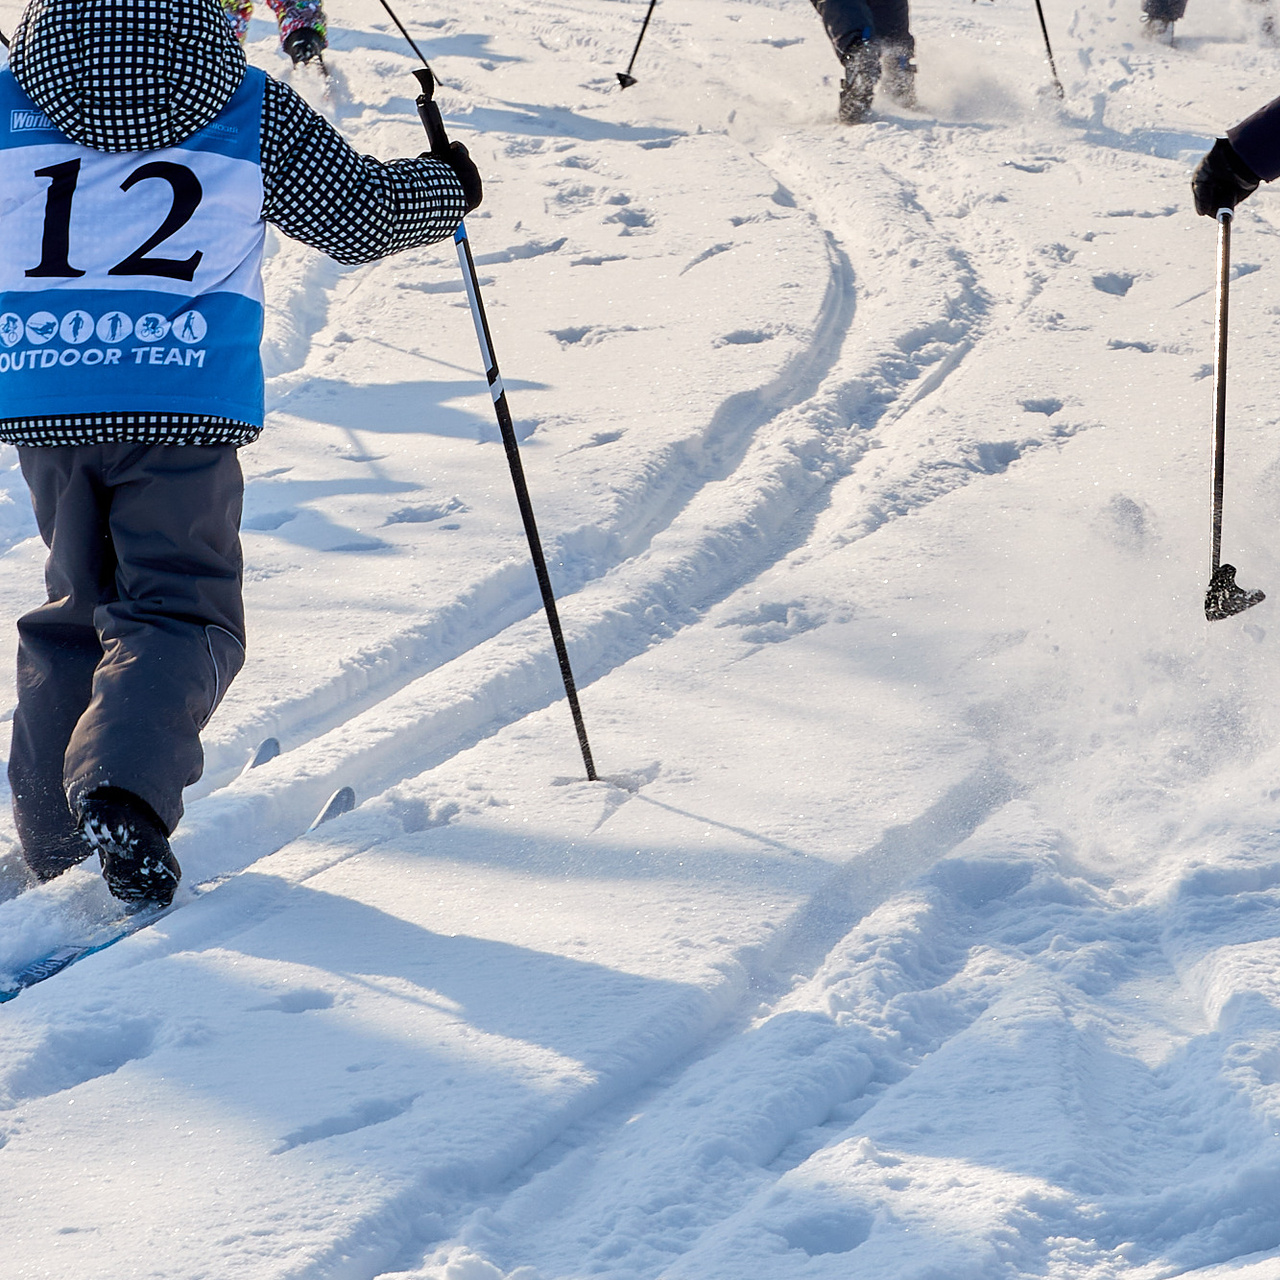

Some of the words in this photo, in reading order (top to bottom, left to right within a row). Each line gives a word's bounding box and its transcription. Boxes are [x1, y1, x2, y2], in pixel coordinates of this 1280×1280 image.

[24, 157, 204, 282] 12
[0, 347, 121, 373] OUTDOOR
[132, 347, 206, 368] TEAM
